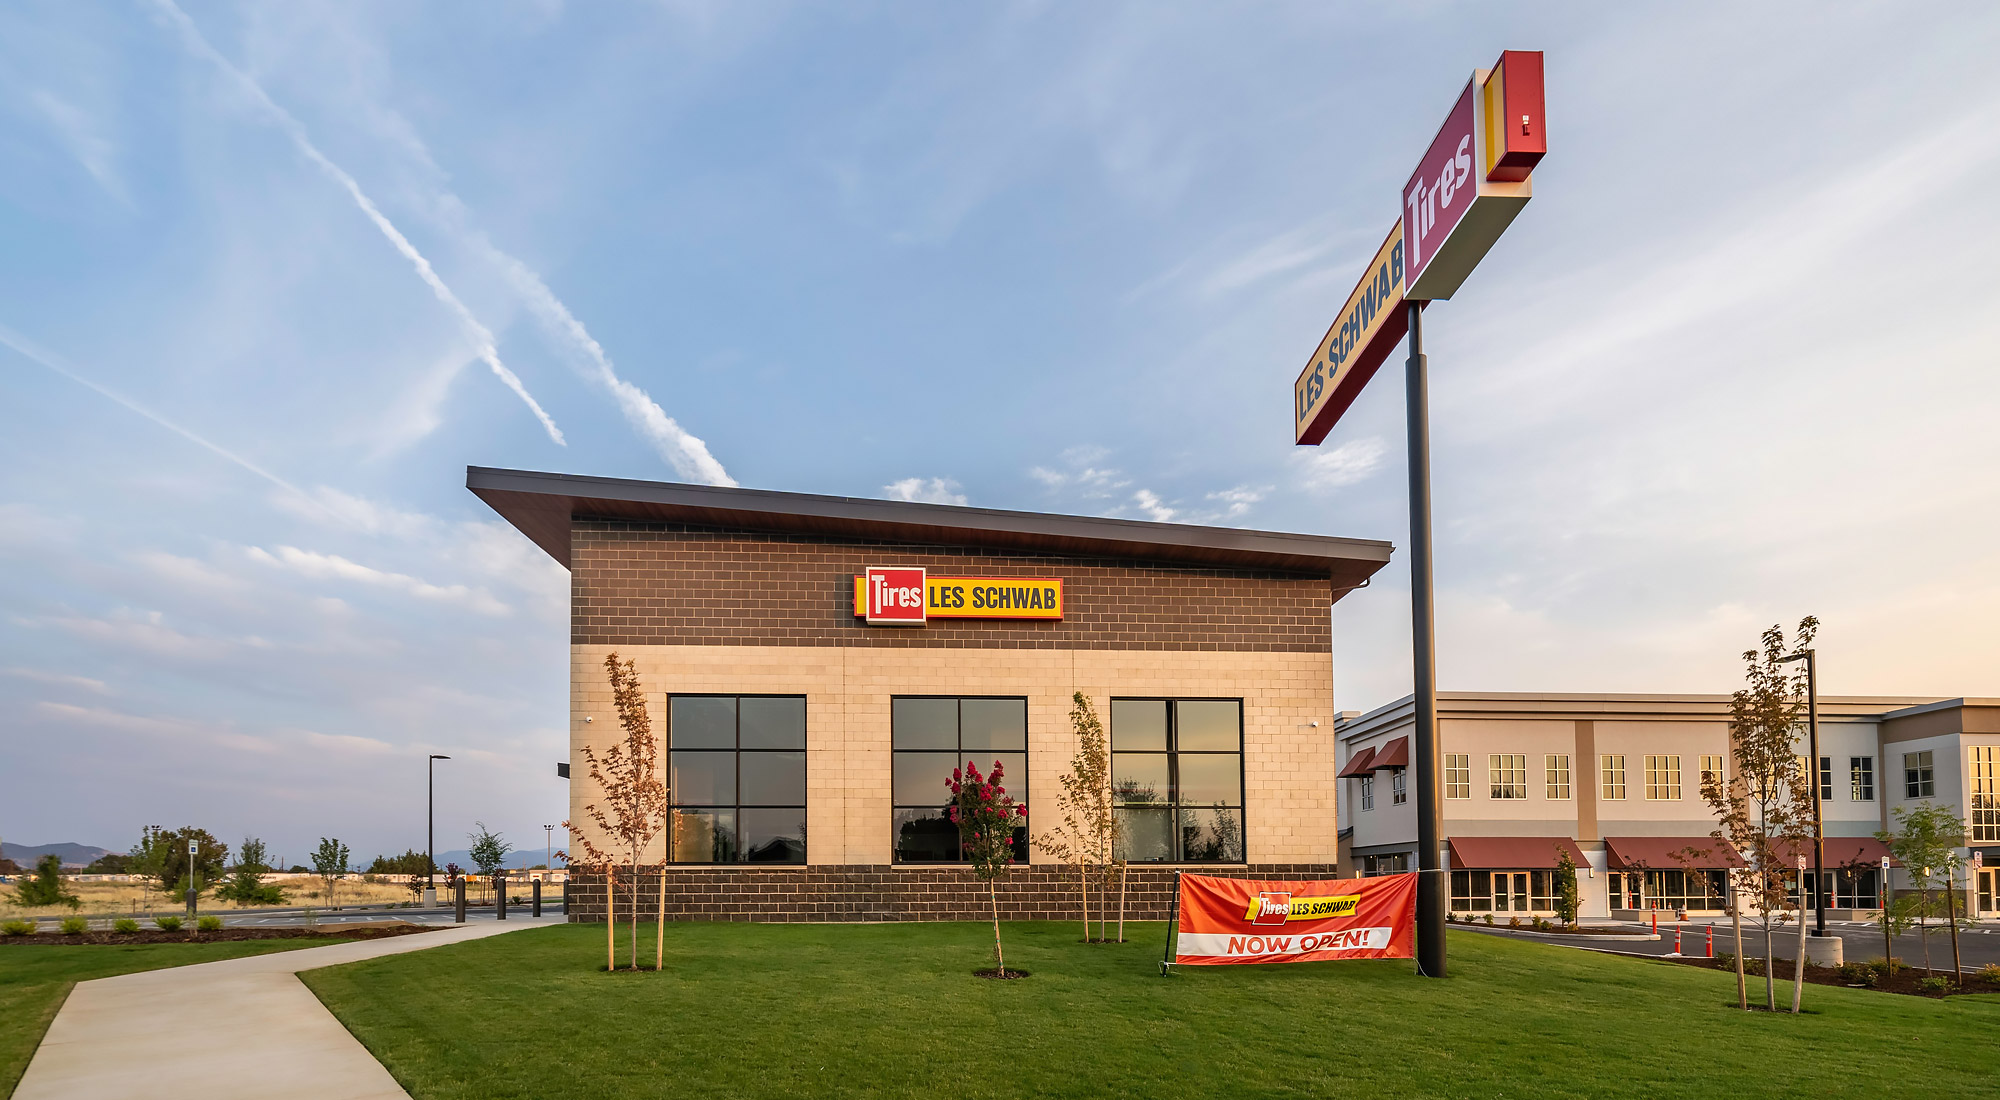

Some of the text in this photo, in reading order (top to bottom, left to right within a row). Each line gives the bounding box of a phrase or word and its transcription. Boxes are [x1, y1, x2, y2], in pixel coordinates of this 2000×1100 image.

[1407, 133, 1471, 268] Tires
[1299, 239, 1403, 423] LES SCHWAB
[871, 574, 1056, 615] Tires LES SCHWAB
[1259, 897, 1356, 917] Tires LES SCHWAB
[1227, 929, 1370, 955] NOW OPEN!
